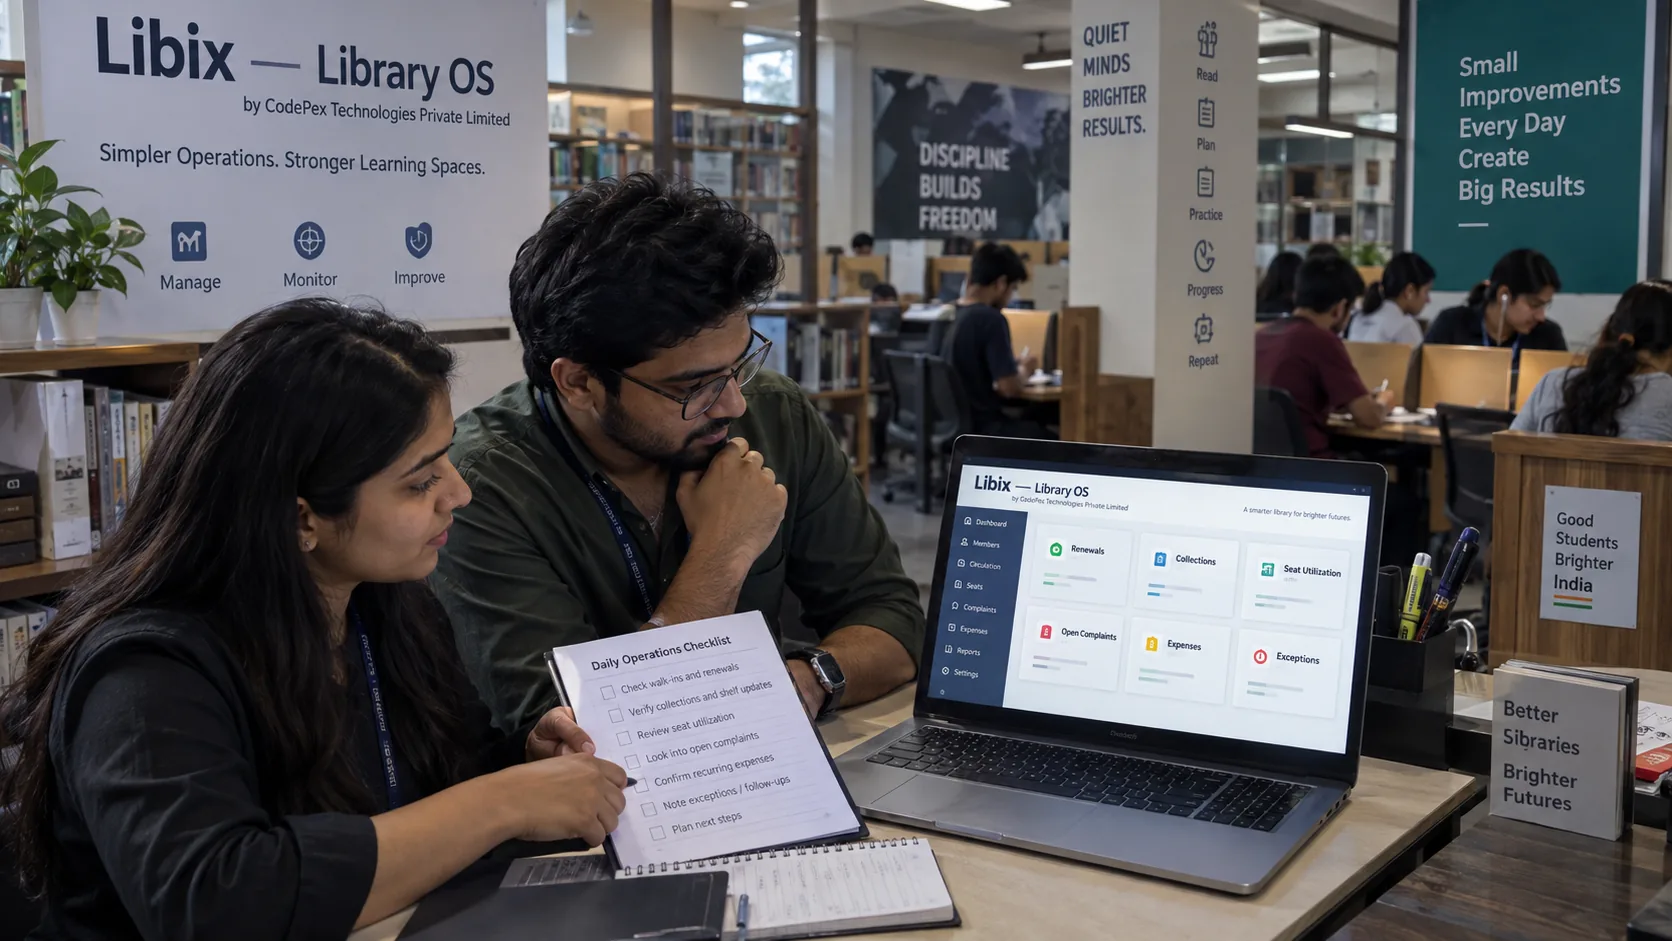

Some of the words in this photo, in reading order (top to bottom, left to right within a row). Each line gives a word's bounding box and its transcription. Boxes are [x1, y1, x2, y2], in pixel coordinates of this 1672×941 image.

[1083, 21, 1130, 47] QUIET
[96, 16, 236, 82] Libix
[317, 44, 441, 102] Library
[449, 57, 495, 96] OS
[1083, 53, 1131, 77] MINDS
[1459, 50, 1518, 77] Small
[1196, 68, 1218, 83] Read
[1083, 84, 1147, 108] BRIGHTER
[1459, 75, 1621, 110] Improvements
[243, 96, 261, 116] by
[265, 98, 328, 117] CodePex
[330, 102, 417, 124] Technologies
[419, 107, 463, 124] Private
[466, 110, 511, 127] Limited
[1083, 114, 1146, 138] RESULTS.
[1459, 117, 1518, 140] Every
[1524, 112, 1567, 137] Day
[1196, 137, 1216, 151] Plan
[100, 142, 172, 168] Simpler
[176, 146, 280, 170] Operations.
[284, 151, 356, 175] Stronger
[359, 154, 427, 178] Learning
[430, 157, 486, 178] Spaces.
[919, 141, 1011, 171] DISCIPLINE
[1458, 147, 1529, 169] Create
[919, 173, 982, 200] BUILDS
[1458, 178, 1494, 205] Big
[1501, 174, 1586, 200] Results
[918, 205, 998, 231] FREEDOM
[1189, 207, 1223, 222] Practice
[160, 274, 222, 293] Manage
[283, 271, 338, 288] Monitor
[394, 269, 446, 286] Improve
[1187, 283, 1224, 298] Progress
[1188, 353, 1219, 369] Repeat
[974, 474, 1011, 492] Libix
[1035, 482, 1072, 498] Library
[1074, 485, 1089, 497] OS
[1012, 495, 1020, 503] by
[1046, 498, 1084, 509] Technologies
[1106, 503, 1129, 512] Limited
[1249, 507, 1272, 515] smarter
[1273, 508, 1293, 518] library
[1303, 510, 1328, 520] brighter
[976, 518, 1008, 528] Dashboard
[1557, 511, 1594, 528] Good
[972, 539, 1001, 549] Members
[1071, 544, 1105, 556] Renewals
[1556, 531, 1619, 550] Students
[1175, 554, 1217, 566] Collections
[1283, 564, 1301, 574] Seat
[1302, 566, 1342, 578] Utilization
[1555, 552, 1614, 572] Brighter
[966, 582, 984, 591] Seats
[1554, 574, 1593, 593] India
[963, 603, 997, 614] Complaints
[960, 625, 988, 635] Expenses
[1061, 628, 1080, 639] Open
[1080, 630, 1117, 642] Complaints
[591, 657, 620, 671] Daily
[621, 645, 682, 665] Operations
[683, 635, 732, 652] Checklist
[1167, 639, 1202, 652] Expenses
[1276, 651, 1320, 665] Exceptions
[621, 681, 648, 694] Check
[649, 673, 684, 687] walk-ins
[685, 670, 702, 681] and
[702, 662, 740, 677] renewals
[953, 668, 979, 679] Settings
[656, 695, 701, 711] collections
[702, 690, 719, 702] and
[719, 685, 739, 698] shelf
[740, 680, 773, 694] updates
[1504, 700, 1559, 724] Better
[636, 726, 670, 740] Review
[671, 721, 691, 733] seat
[692, 712, 736, 728] utilization
[646, 750, 669, 763] Look
[669, 746, 688, 758] into
[689, 741, 713, 755] open
[713, 731, 760, 748] complaints
[654, 771, 692, 787] Confirm
[692, 762, 734, 778] recurring
[734, 753, 775, 769] expenses
[1503, 762, 1578, 789] Brighter
[662, 797, 687, 810] Note
[688, 787, 738, 805] exceptions
[744, 775, 791, 793] follow-ups
[1503, 786, 1572, 811] Futures
[671, 822, 694, 835] Plan
[695, 816, 717, 828] next
[717, 811, 743, 825] steps
